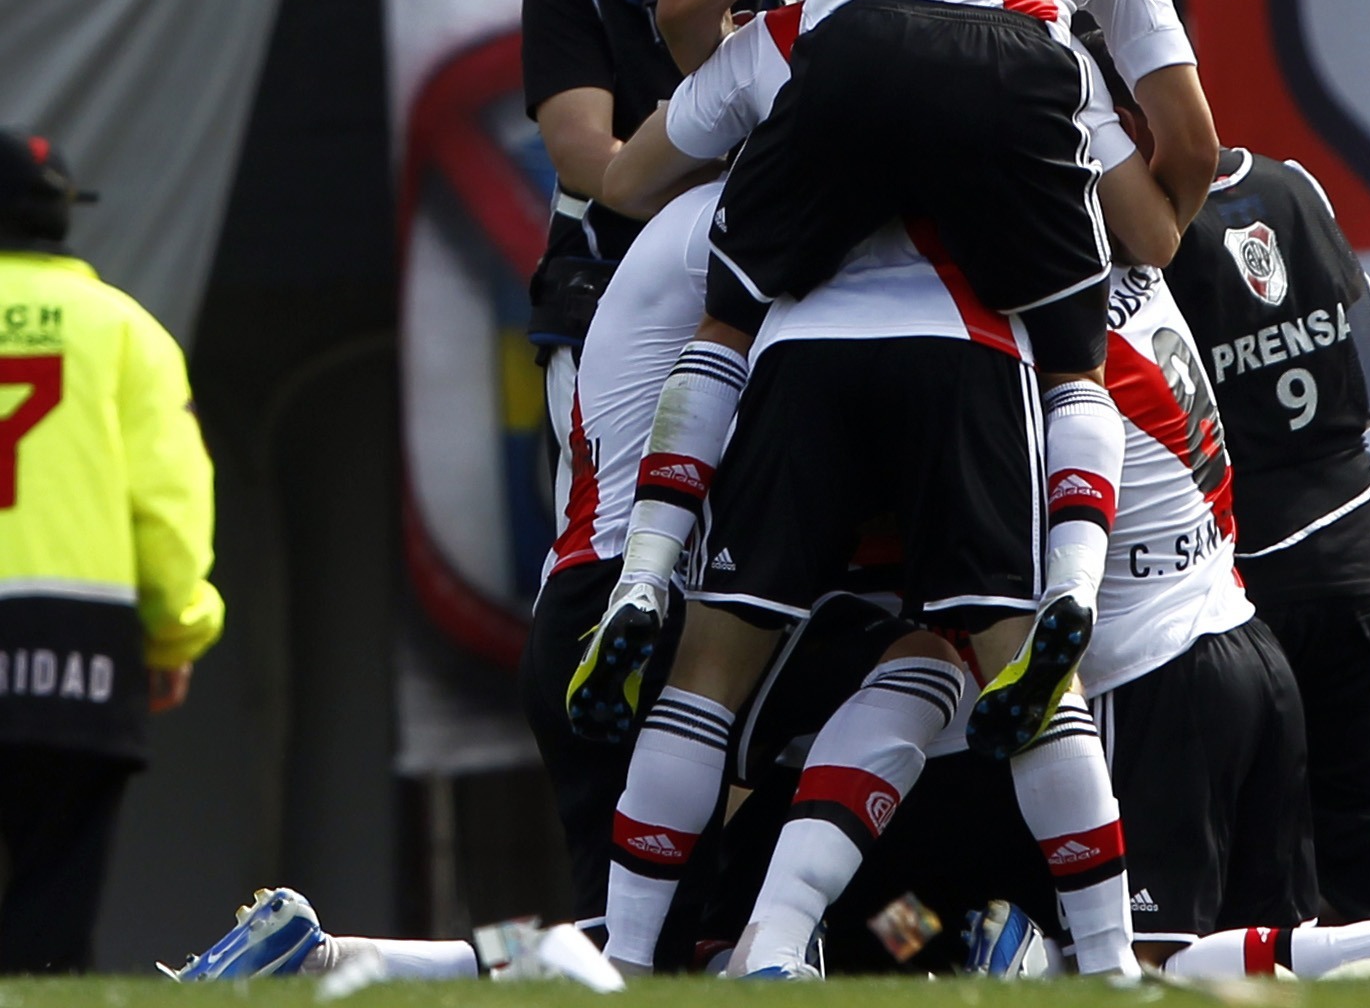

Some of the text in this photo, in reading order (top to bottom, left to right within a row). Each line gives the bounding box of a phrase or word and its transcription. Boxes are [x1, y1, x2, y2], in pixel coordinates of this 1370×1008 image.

[1211, 302, 1351, 384] PRENSA
[1276, 367, 1318, 431] 9
[649, 469, 705, 491] adidas
[1130, 514, 1224, 578] C. SAN
[711, 561, 736, 571] adidas
[627, 838, 682, 857] adidas
[1048, 847, 1101, 865] adidas
